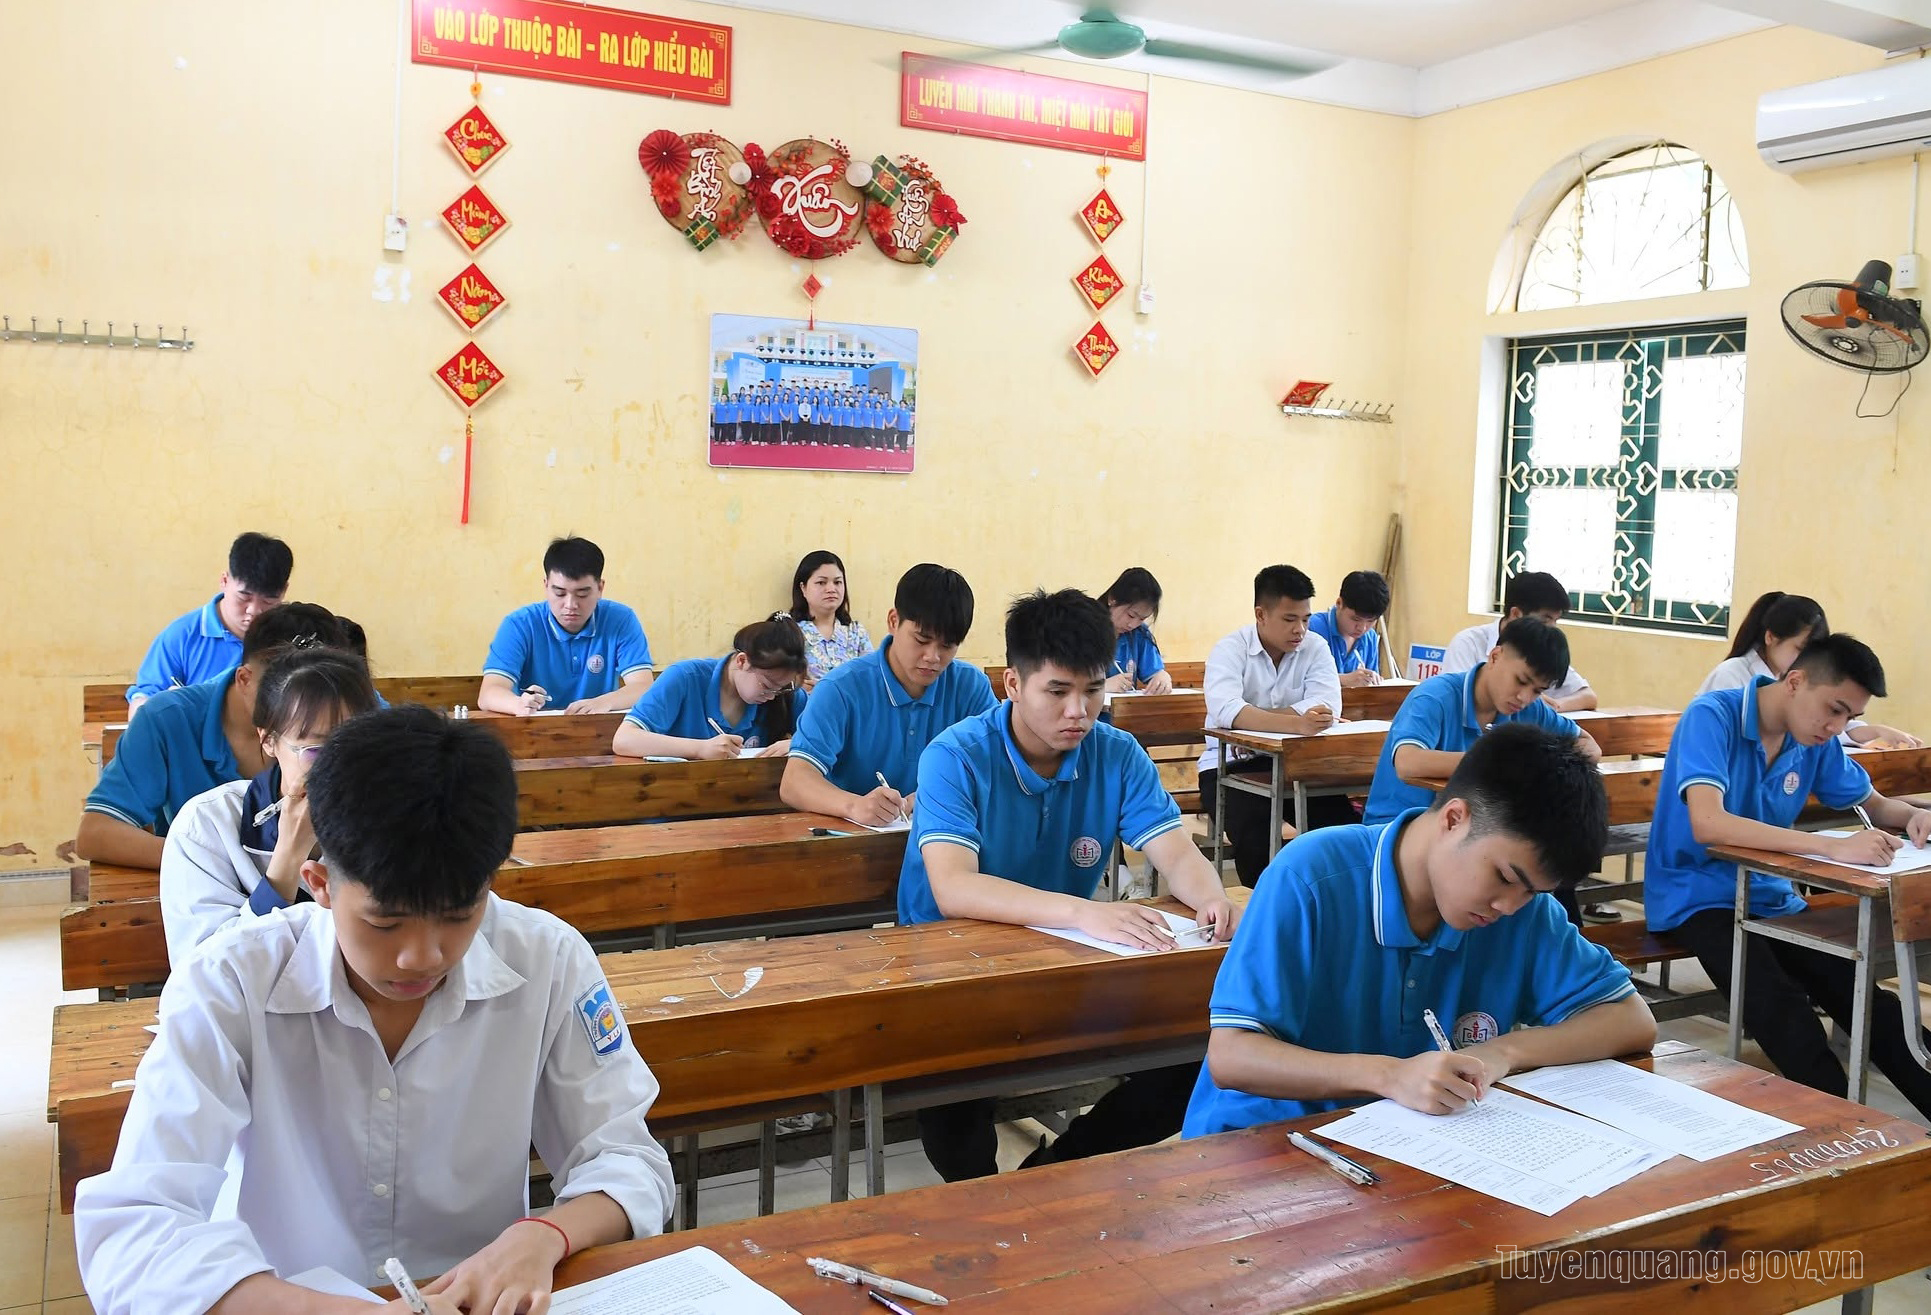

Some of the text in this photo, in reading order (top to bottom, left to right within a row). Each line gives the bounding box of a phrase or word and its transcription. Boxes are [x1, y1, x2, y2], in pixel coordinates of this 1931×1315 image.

[434, 2, 465, 43] VÀO
[470, 7, 499, 47] LỚP
[503, 15, 552, 60] THUỘC
[556, 21, 582, 60] BÀI
[599, 31, 619, 65] RA
[623, 31, 650, 69] LỚP
[653, 30, 687, 75] HIỂU
[690, 41, 714, 79] BÀI
[919, 75, 953, 115] LUYỆN
[459, 118, 493, 142] Chúc
[770, 164, 860, 239] Xuân
[459, 275, 493, 303] Năm
